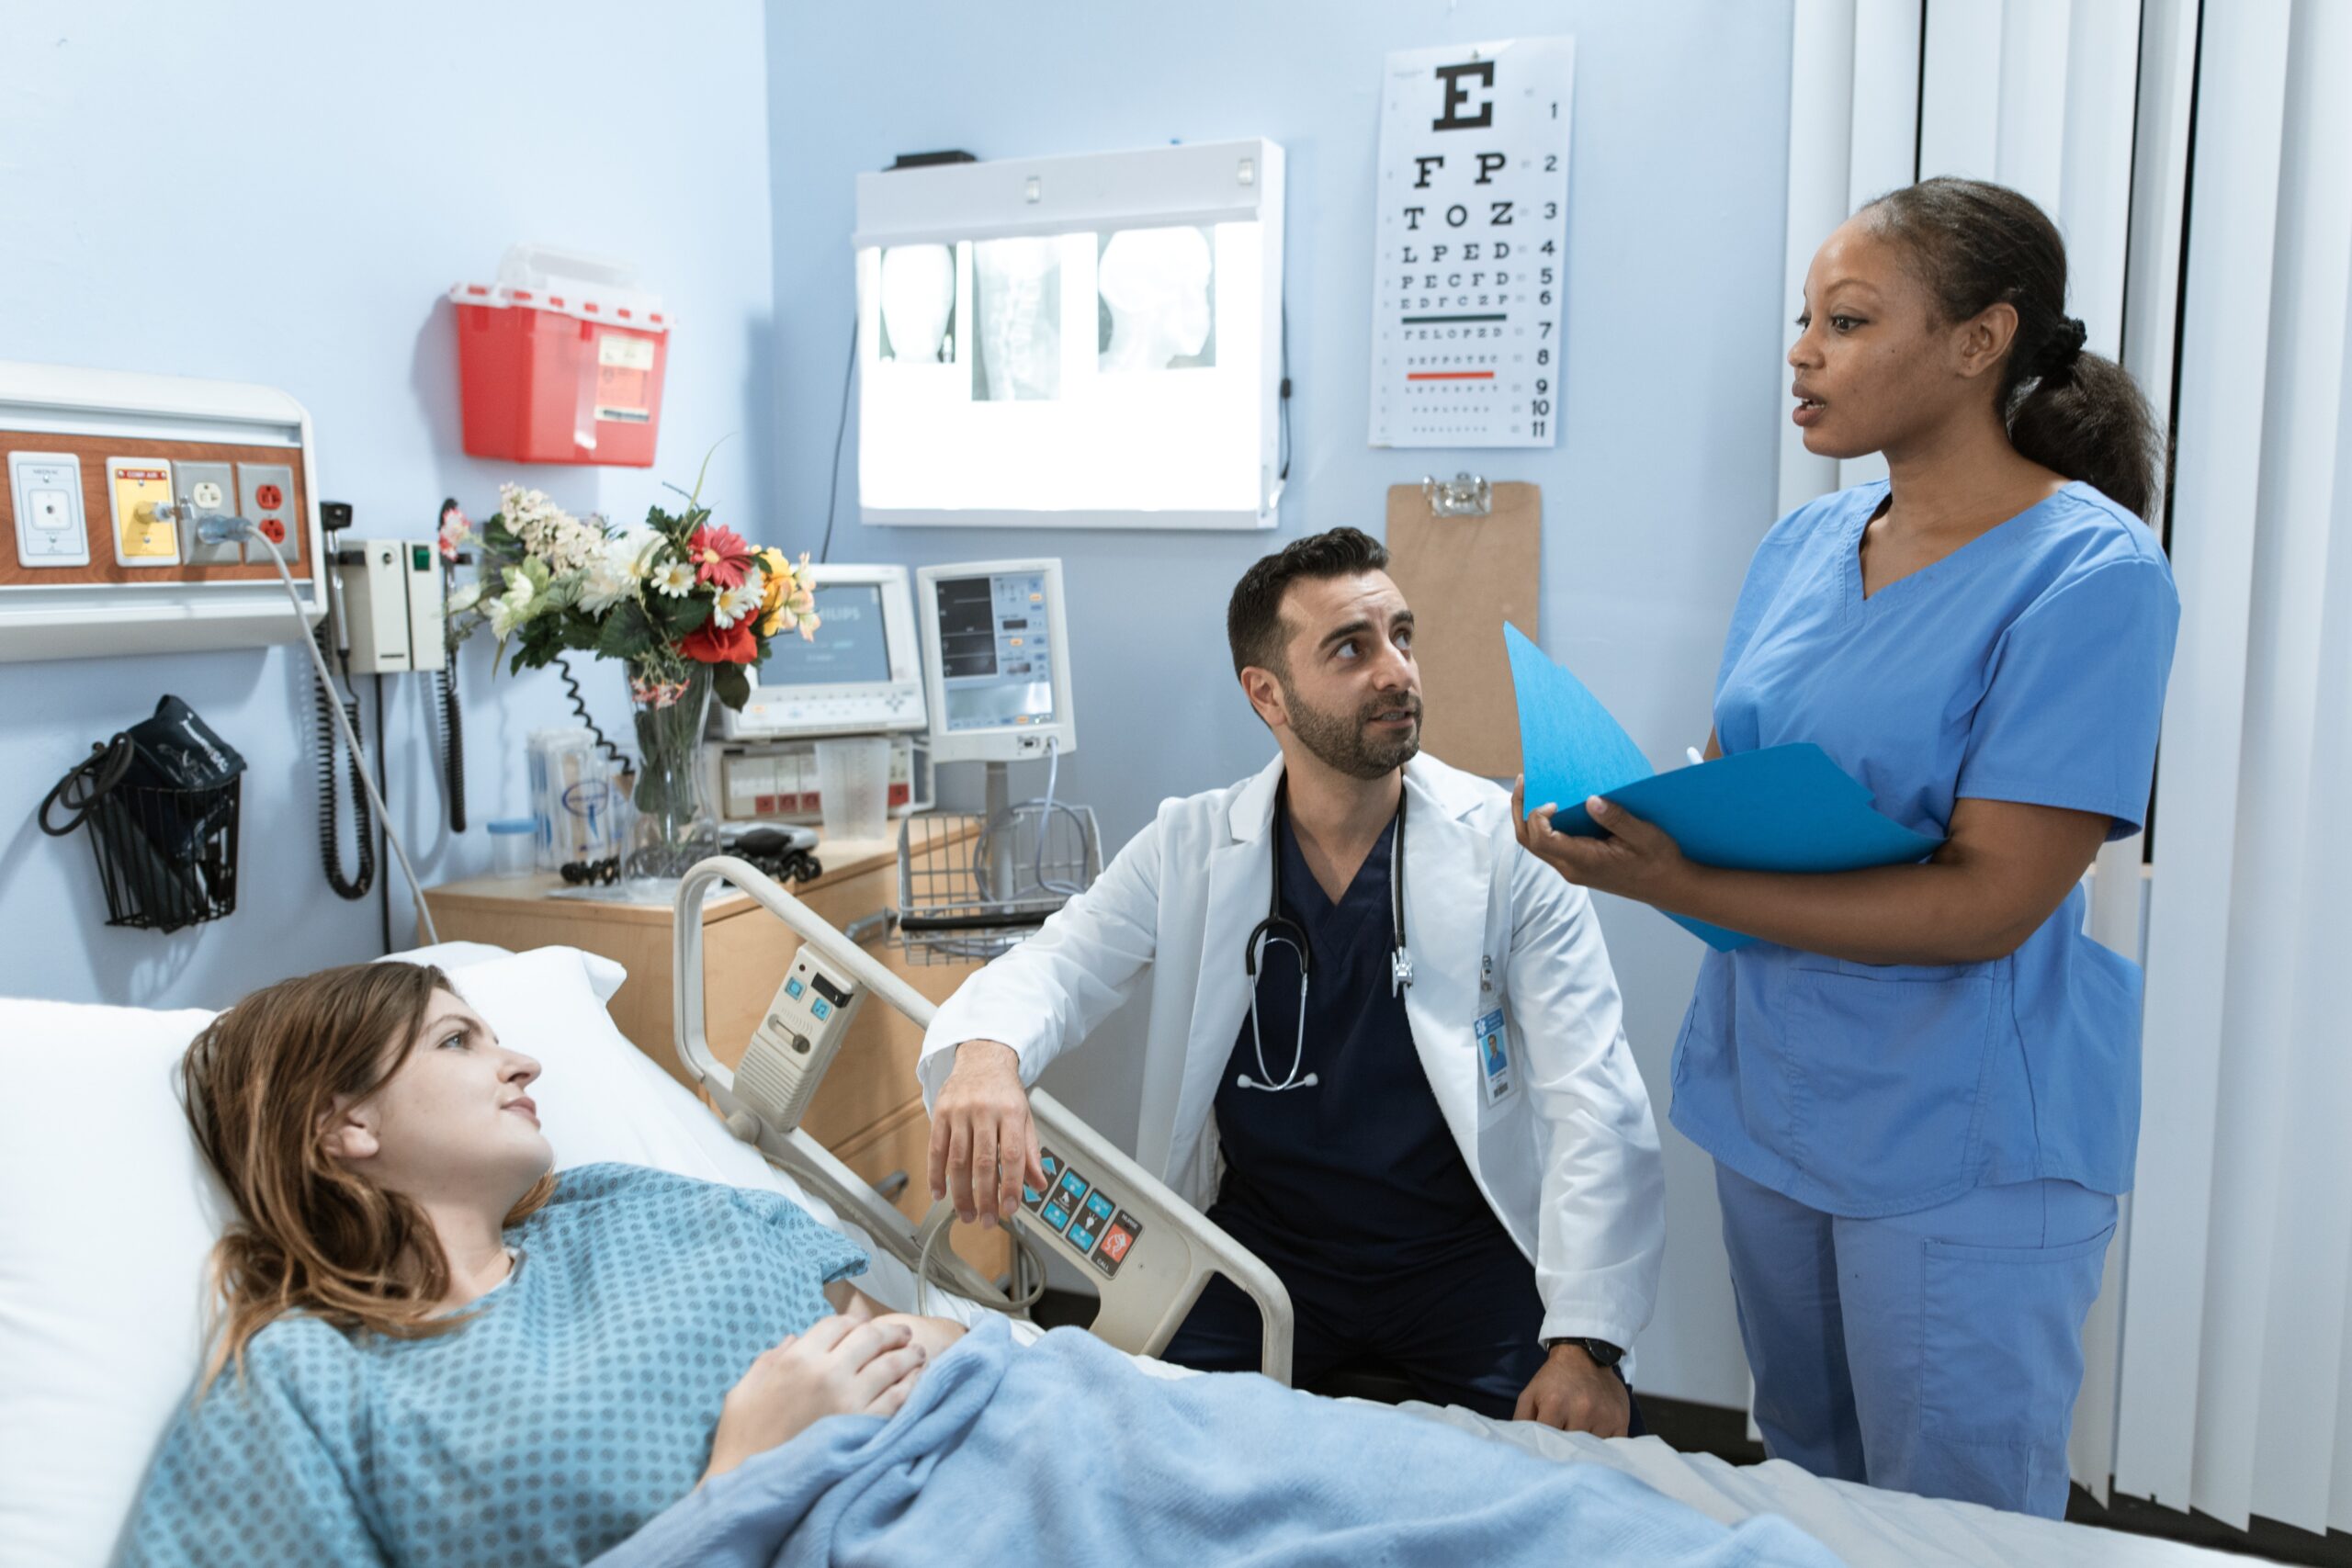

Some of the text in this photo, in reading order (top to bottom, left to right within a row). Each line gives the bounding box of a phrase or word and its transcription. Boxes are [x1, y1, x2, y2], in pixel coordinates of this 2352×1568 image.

[1431, 60, 1496, 133] E
[1550, 101, 1558, 120] 1
[1544, 153, 1558, 174] 2
[1544, 200, 1558, 220] 3
[1540, 239, 1555, 257] 4
[1540, 267, 1554, 286] 5
[1539, 289, 1552, 306] 6
[1539, 321, 1553, 340] 7
[1536, 348, 1550, 366] 8
[1535, 378, 1548, 395] 9
[1532, 399, 1550, 416] 10
[1532, 420, 1545, 437] 11
[1121, 1213, 1138, 1230] NURSE
[1096, 1258, 1110, 1271] CALL
